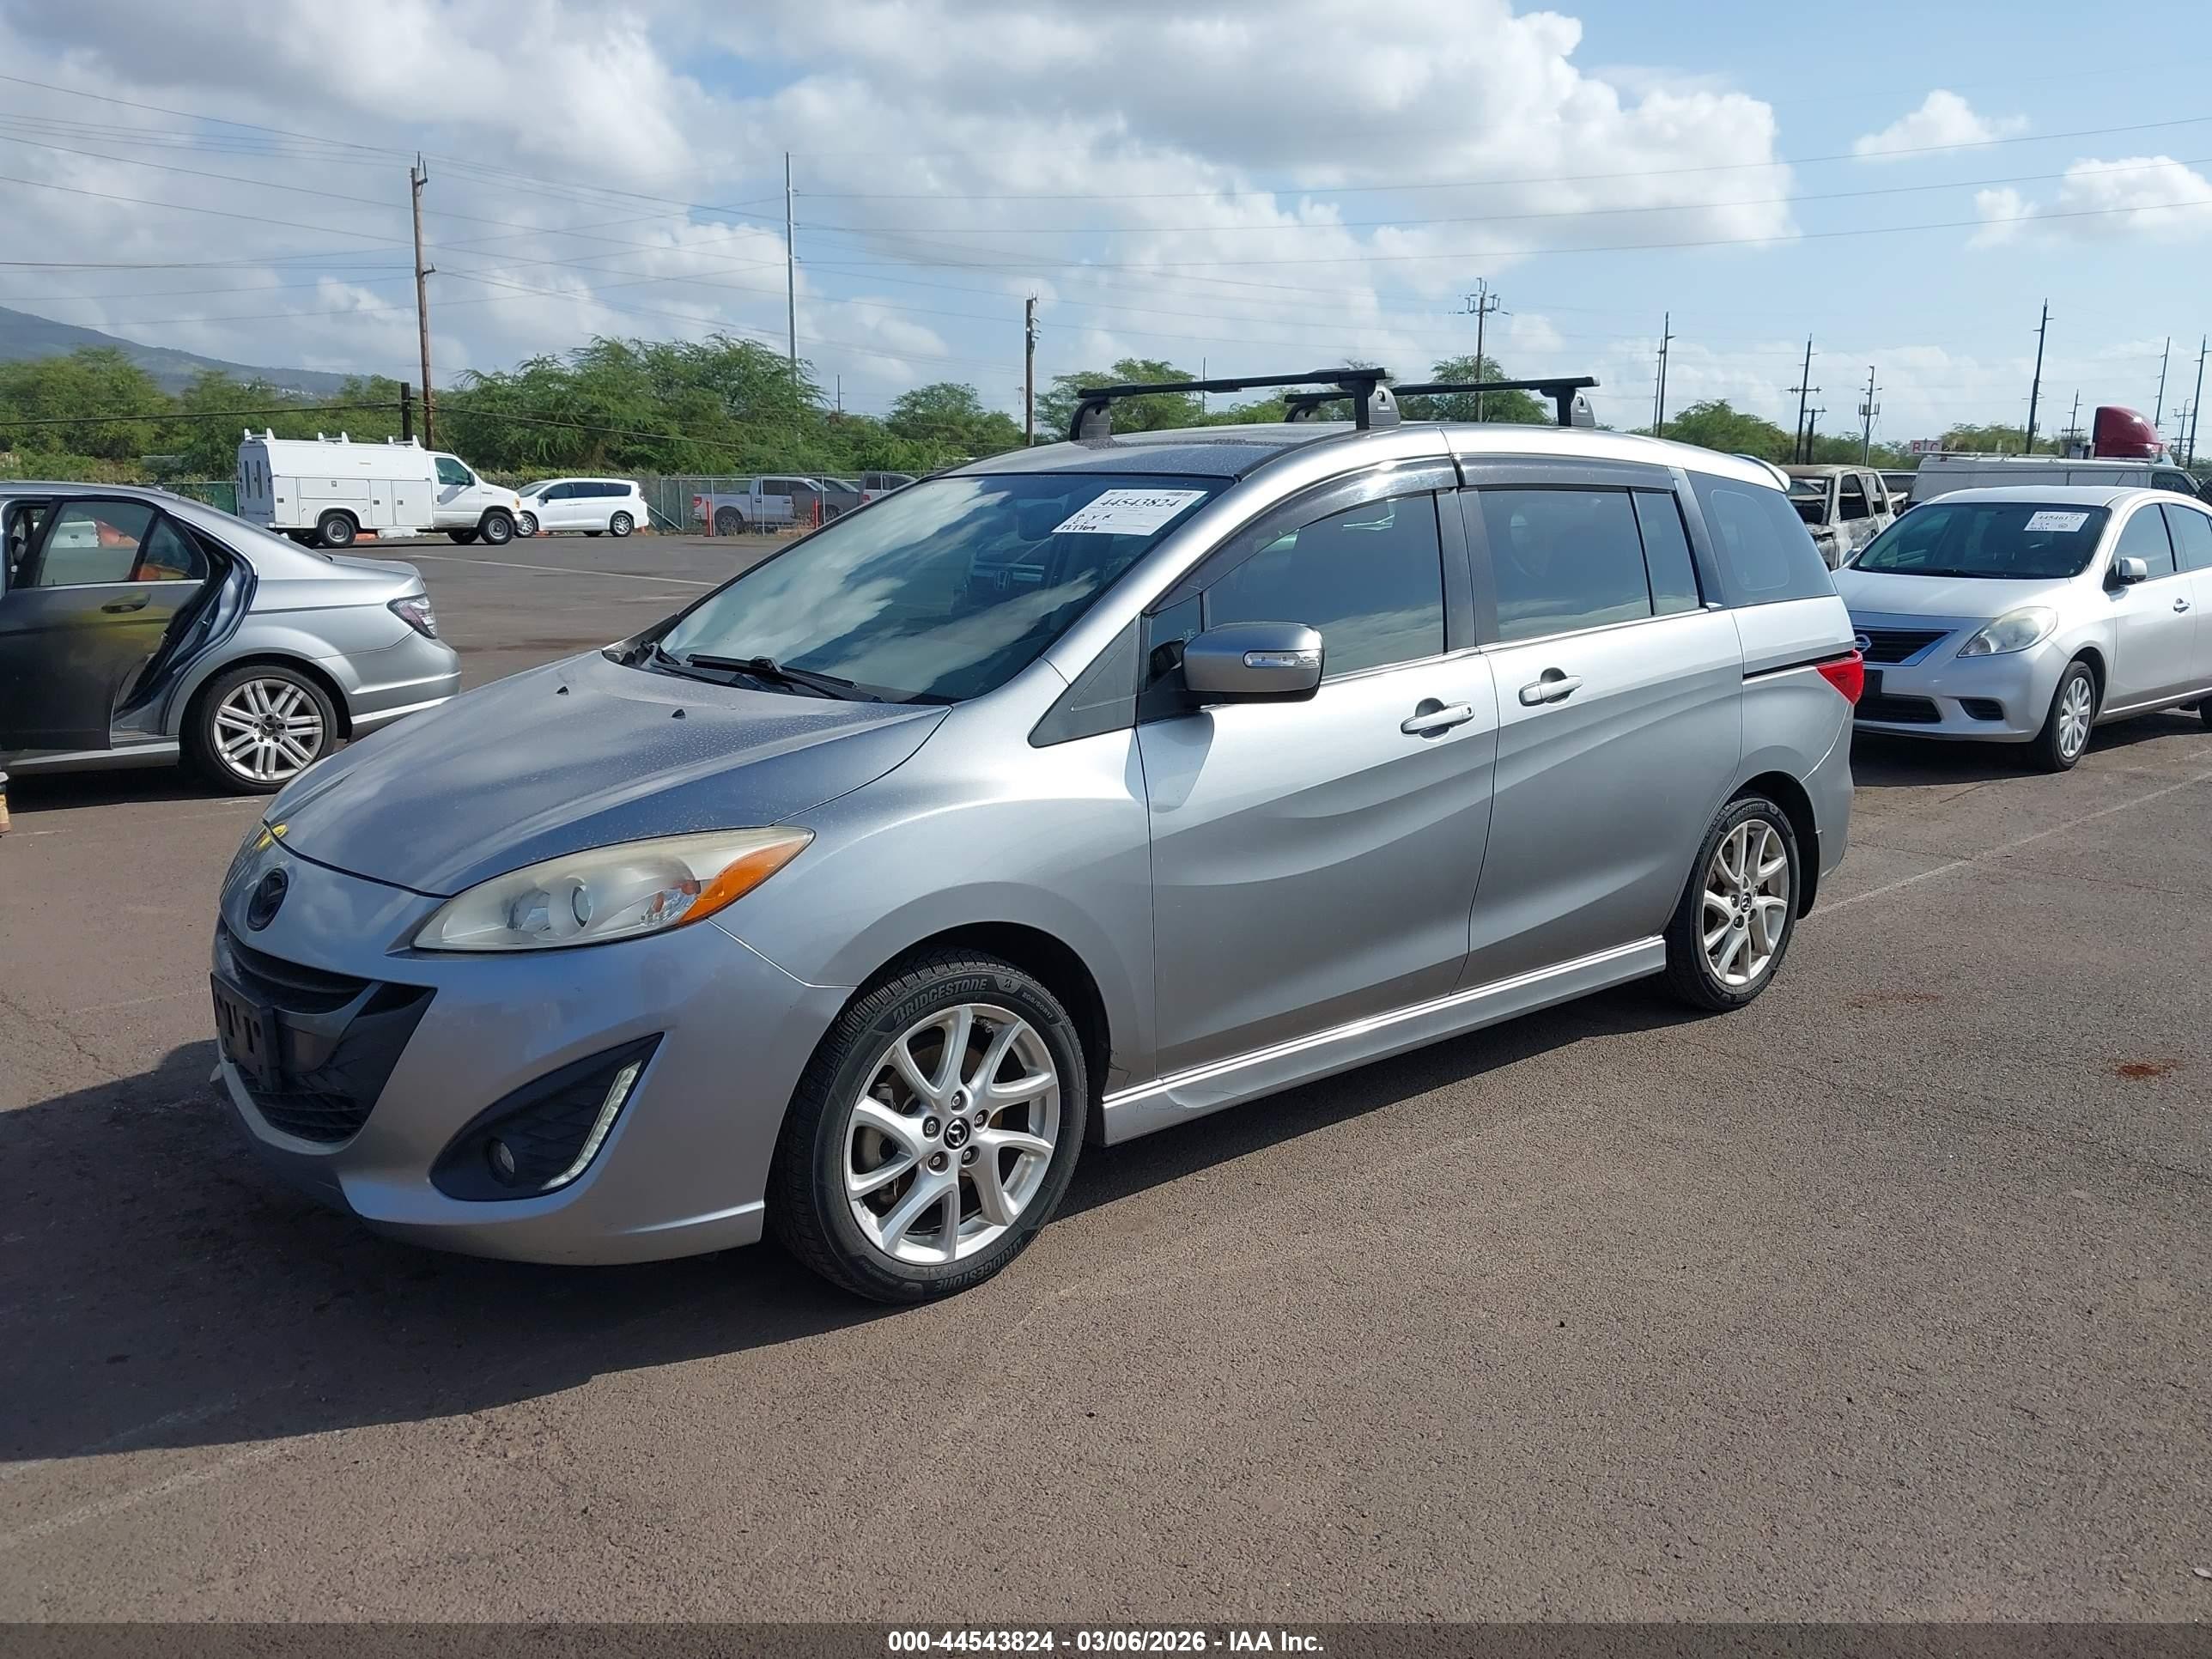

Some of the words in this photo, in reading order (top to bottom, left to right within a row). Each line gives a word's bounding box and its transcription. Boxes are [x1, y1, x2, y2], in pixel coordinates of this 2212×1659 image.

[1100, 498, 1181, 507] 44543824
[893, 978, 988, 1027] BRIDGESTONE
[1022, 992, 1053, 1018] 205/50R17
